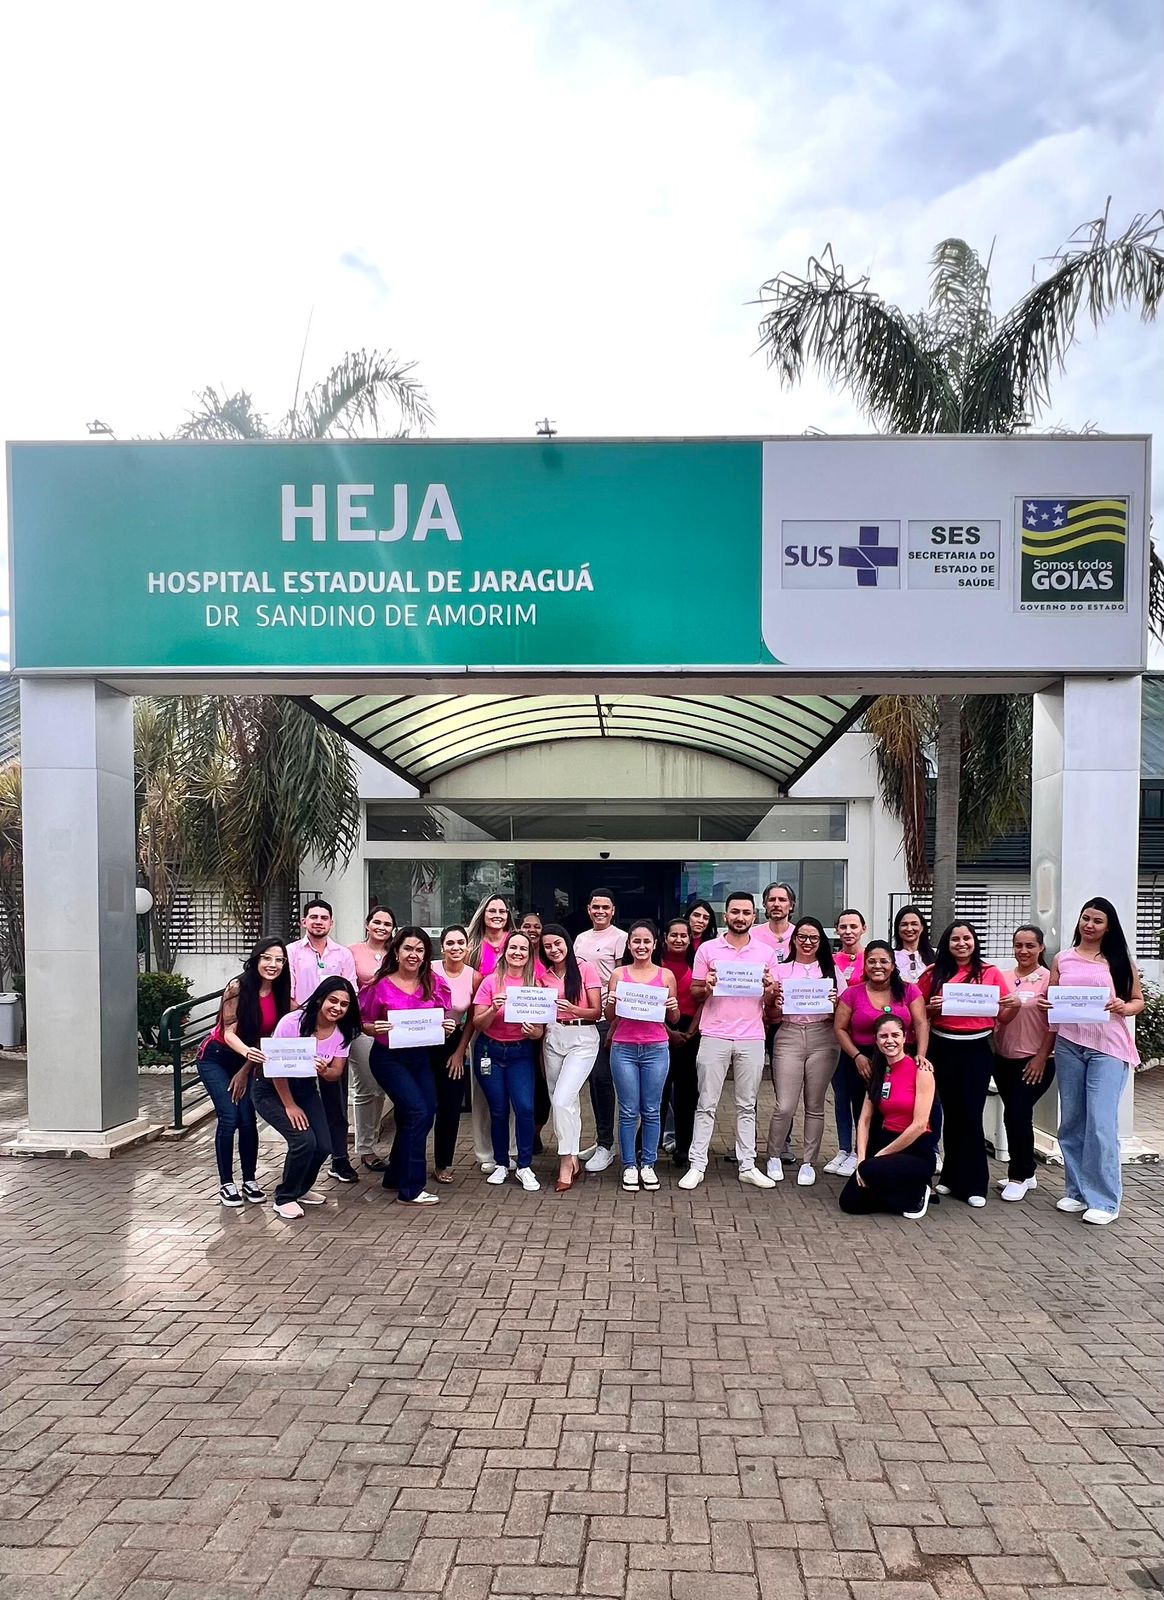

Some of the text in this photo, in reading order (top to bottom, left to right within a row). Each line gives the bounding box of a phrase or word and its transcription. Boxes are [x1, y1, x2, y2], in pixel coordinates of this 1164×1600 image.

[280, 483, 462, 542] HEJA
[931, 526, 981, 545] SES
[784, 545, 834, 567] SUS
[908, 551, 996, 560] SECRETARIA DO
[934, 565, 995, 574] ESTADO DE
[1033, 559, 1113, 571] Somos todos
[148, 563, 594, 594] HOSPITAL ESTADUAL DE JARAGUÁ
[958, 576, 995, 587] SAÚDE
[205, 603, 537, 627] DR SANDINO DE AMORIM
[1020, 603, 1125, 612] GOVERNO DO ESTADO
